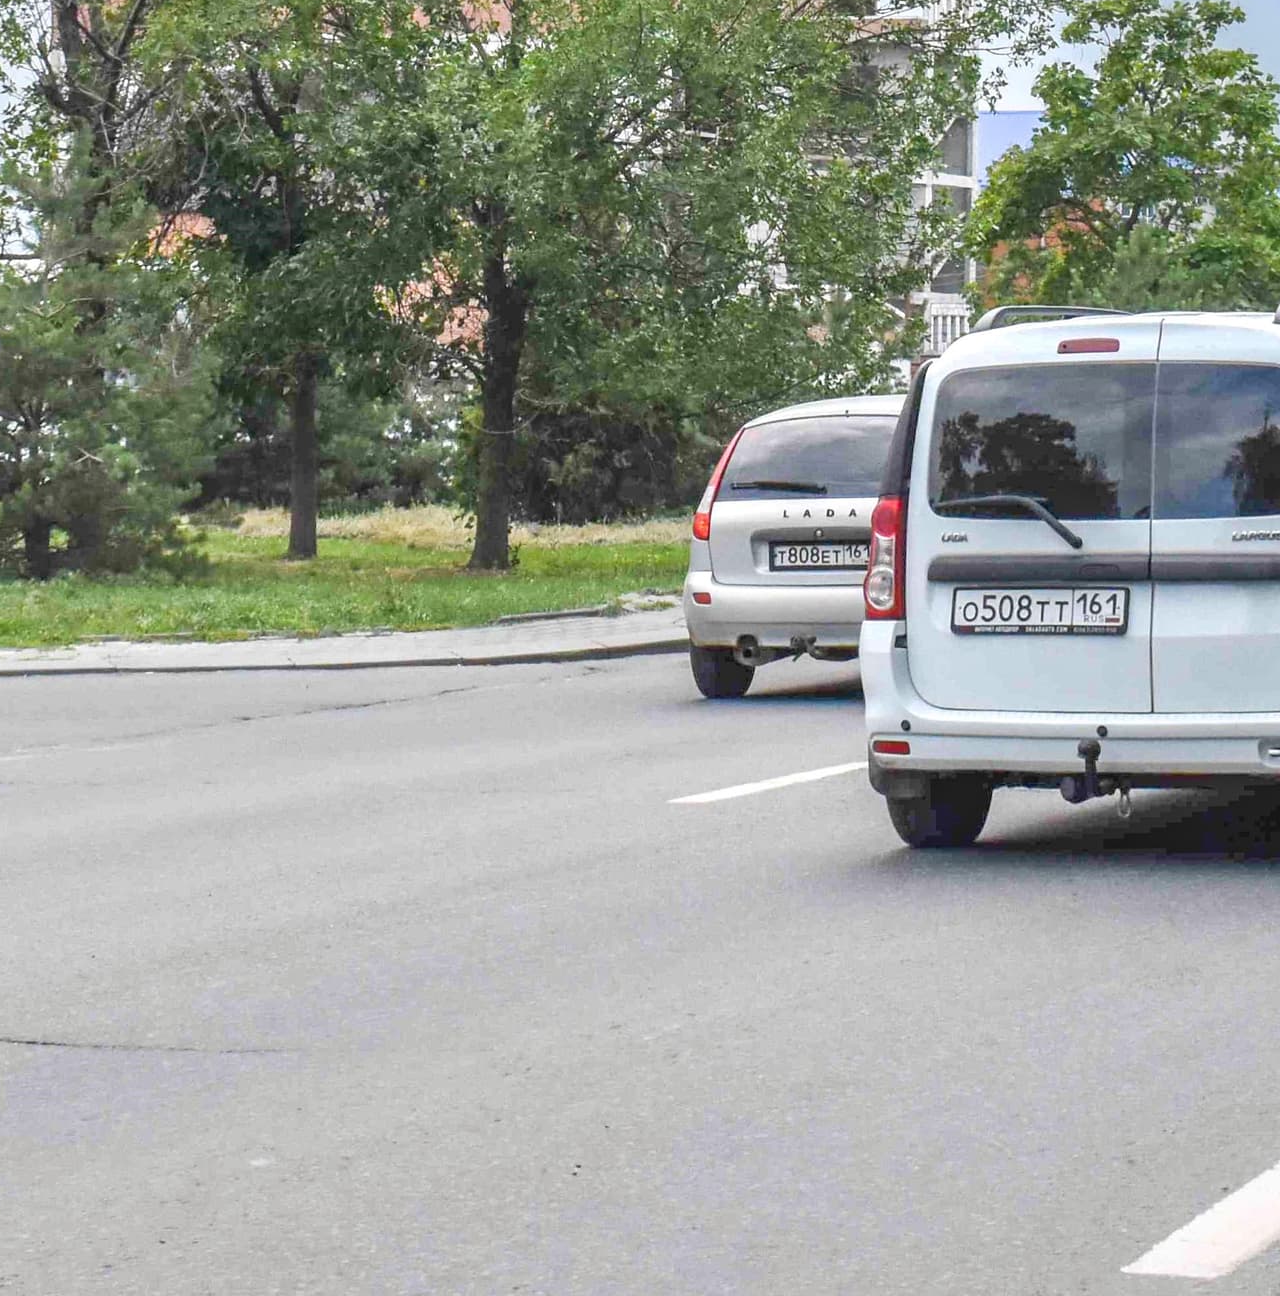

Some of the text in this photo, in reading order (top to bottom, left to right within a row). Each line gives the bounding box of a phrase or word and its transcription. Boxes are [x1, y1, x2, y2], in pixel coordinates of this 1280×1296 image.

[783, 508, 857, 518] LADA
[941, 533, 968, 542] LADA
[778, 547, 841, 564] Т808ЕТ
[962, 593, 1119, 622] О508ТТ 161
[1083, 615, 1105, 623] RUS
